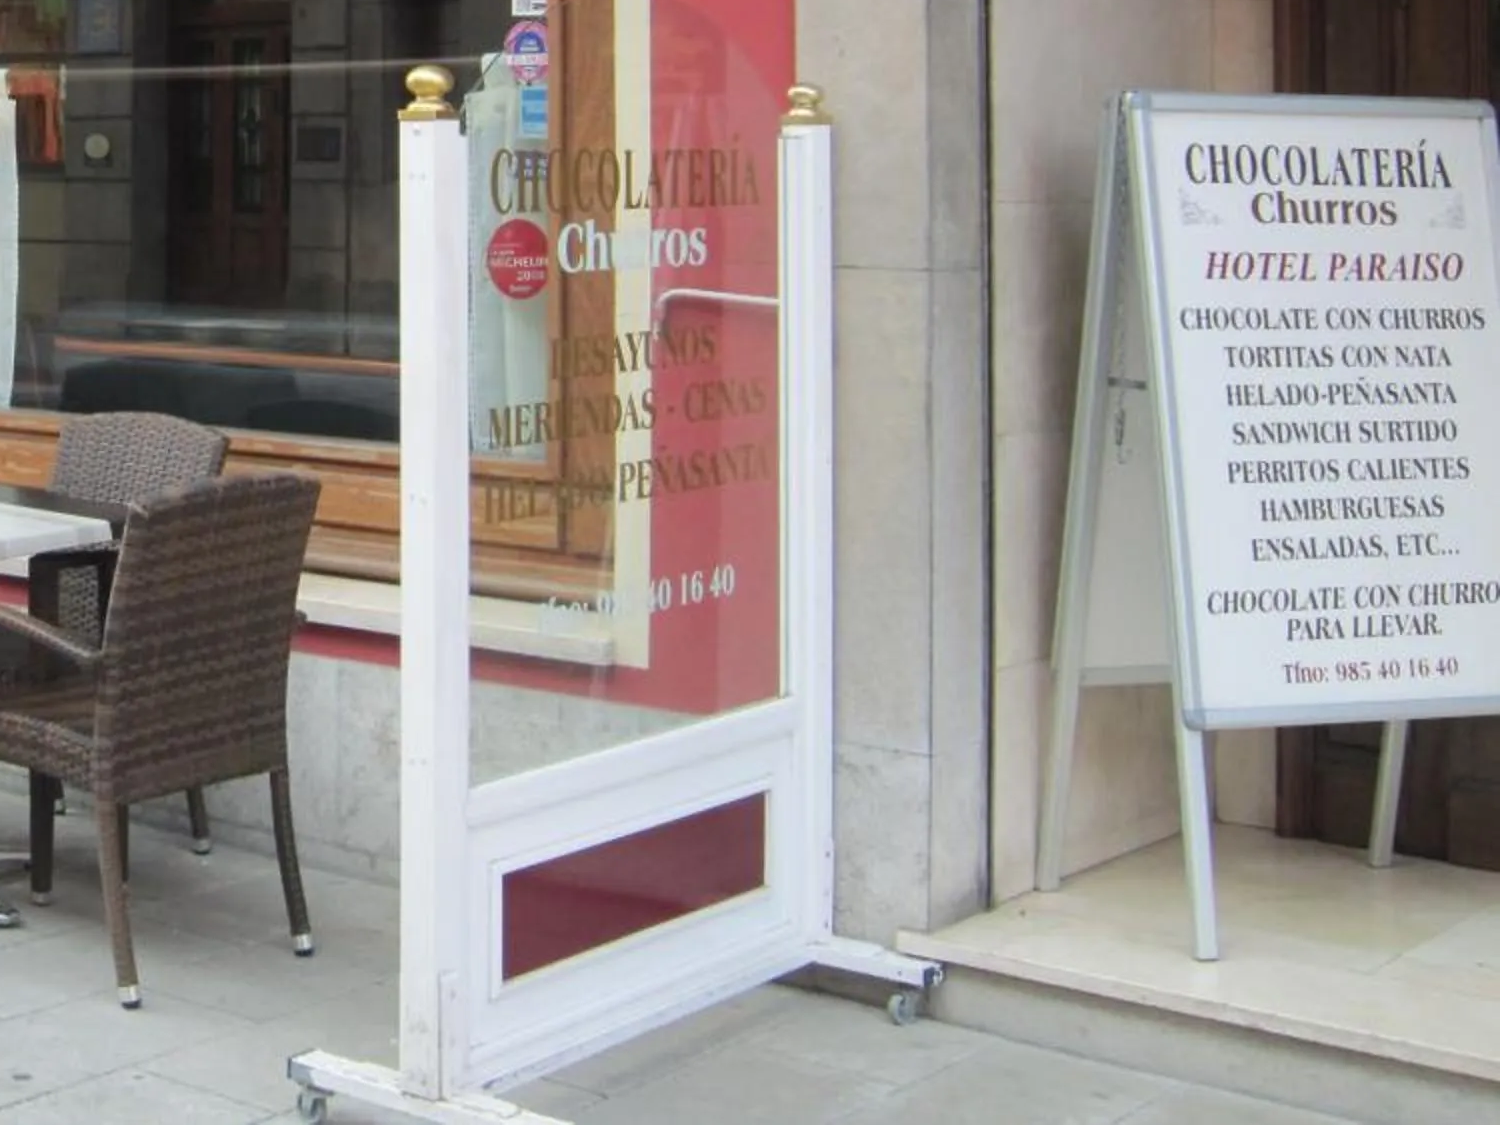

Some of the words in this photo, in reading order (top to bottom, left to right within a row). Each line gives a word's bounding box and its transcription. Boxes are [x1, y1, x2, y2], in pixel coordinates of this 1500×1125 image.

[490, 133, 760, 215] CHOCOLATERÍA
[1185, 139, 1453, 189] CHOCOLATERÍA
[1251, 190, 1397, 226] Churros
[557, 219, 708, 273] Churos
[1206, 251, 1317, 282] HOTEL
[1327, 251, 1465, 282] PARAISO
[1179, 307, 1319, 331] CHOCOLATE
[1325, 307, 1371, 331] CON
[1379, 307, 1486, 331] CHURROS
[552, 325, 716, 379] DESAYUNOS
[1223, 345, 1334, 369] TORTITAS
[1341, 345, 1387, 368] CON
[1395, 344, 1453, 368] NATA
[488, 388, 657, 450] MERIENDAS
[683, 377, 767, 423] CENAS
[1232, 421, 1351, 446] SANDWICH
[1359, 419, 1458, 444] SURTIDO
[1227, 459, 1341, 485] PERRITOS
[1347, 456, 1471, 482] CALIENTES
[1260, 494, 1445, 523] HAMBURGUESAS
[1251, 535, 1389, 562] ENSALADAS,
[681, 570, 704, 606] 16
[709, 563, 736, 598] 40
[1207, 587, 1345, 615] CHOCOLATE
[1354, 584, 1401, 609] CON
[1286, 617, 1345, 643] PARA
[1335, 661, 1372, 683] 985
[1379, 659, 1401, 681] 40
[1408, 658, 1430, 680] 16
[1436, 655, 1459, 677] 40
